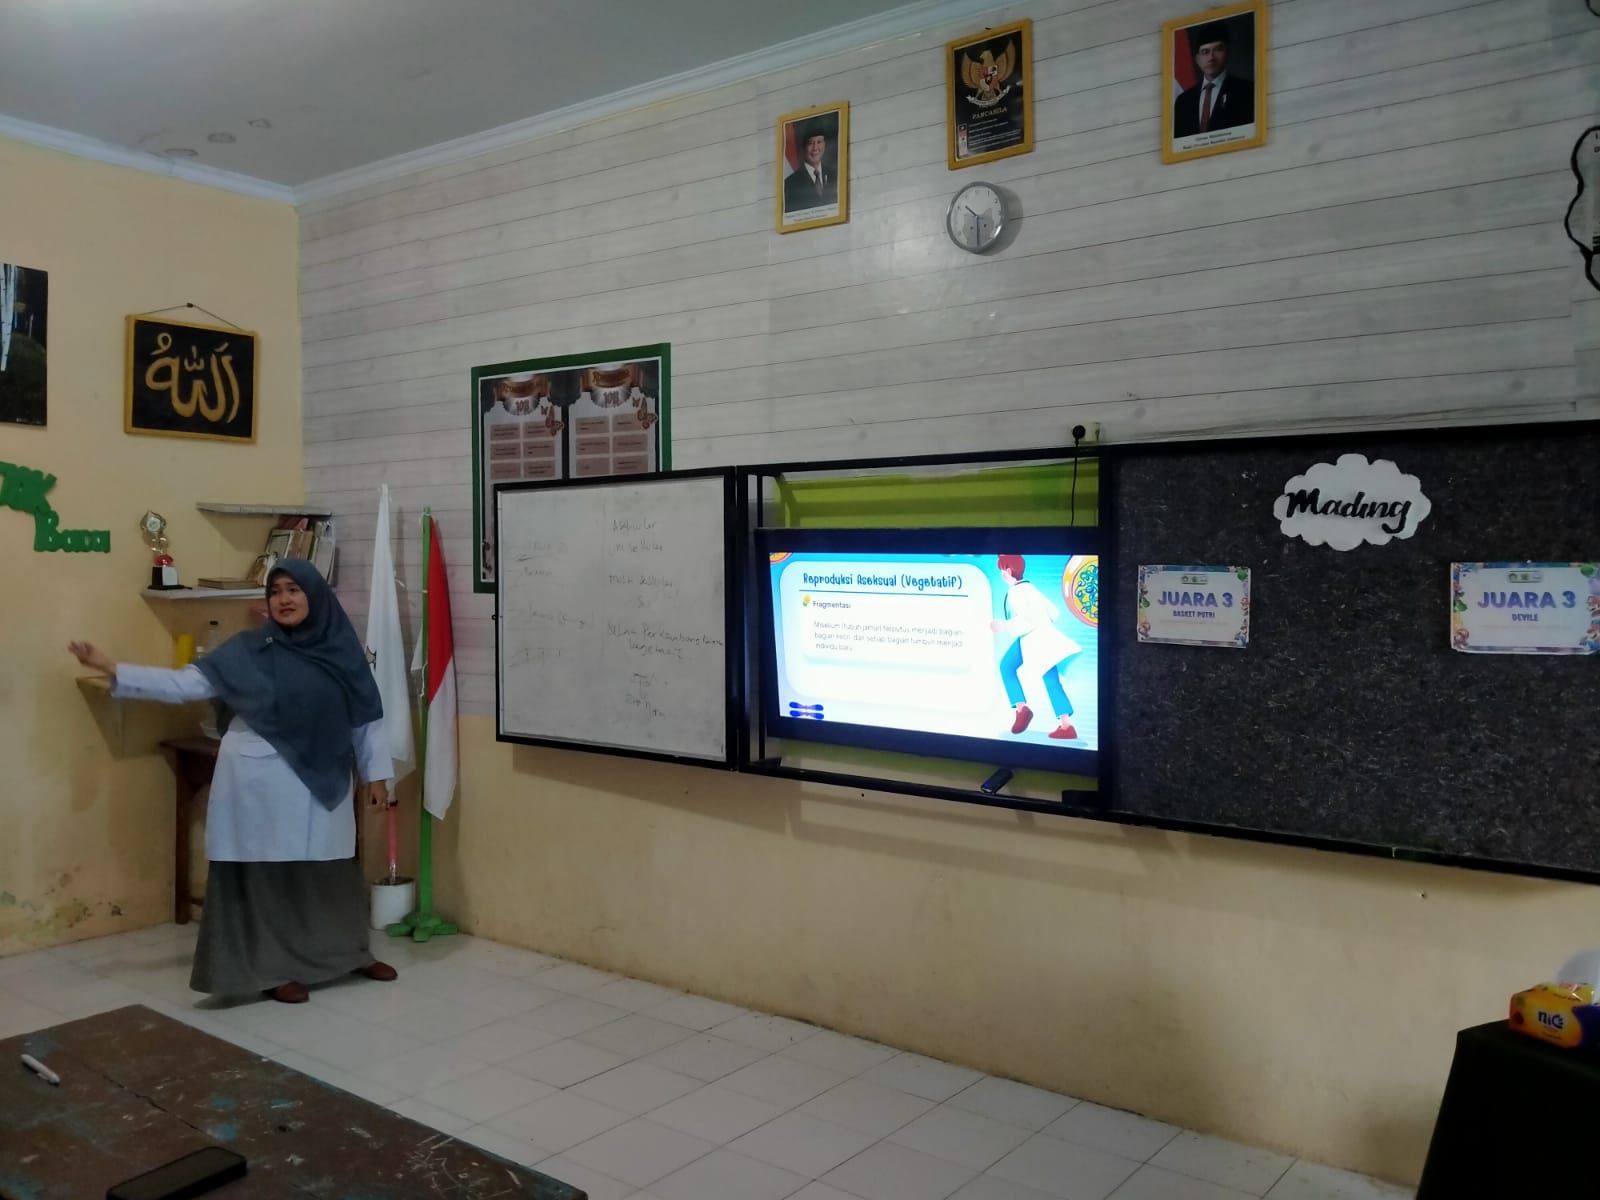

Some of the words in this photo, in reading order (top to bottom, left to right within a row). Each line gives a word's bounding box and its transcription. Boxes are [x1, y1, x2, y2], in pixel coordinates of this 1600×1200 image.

[1285, 487, 1413, 534] Mading
[803, 572, 853, 588] Reproduksi
[857, 574, 897, 587] Aseksual
[900, 575, 963, 592] (Vegetatif)
[812, 600, 852, 610] Fragmentasi
[1158, 590, 1219, 608] JUARA
[1221, 592, 1233, 608] 3
[1477, 591, 1557, 609] JUARA
[1561, 590, 1577, 609] 3
[1173, 610, 1196, 618] BASKET
